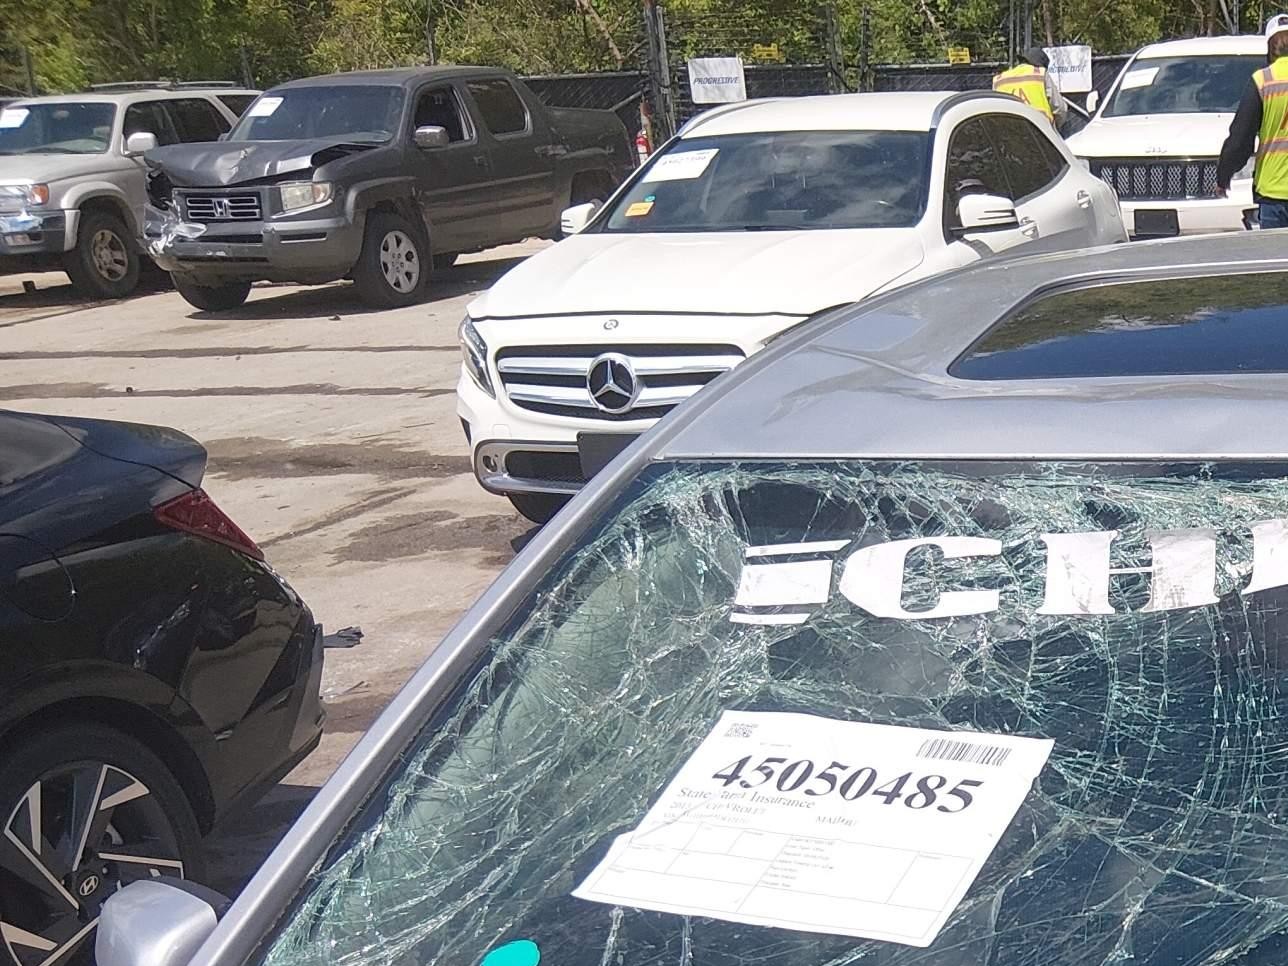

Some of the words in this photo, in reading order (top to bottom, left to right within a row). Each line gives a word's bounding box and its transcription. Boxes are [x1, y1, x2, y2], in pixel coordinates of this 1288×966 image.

[677, 787, 712, 800] State
[750, 791, 816, 809] Insurance
[712, 755, 984, 813] 45050485
